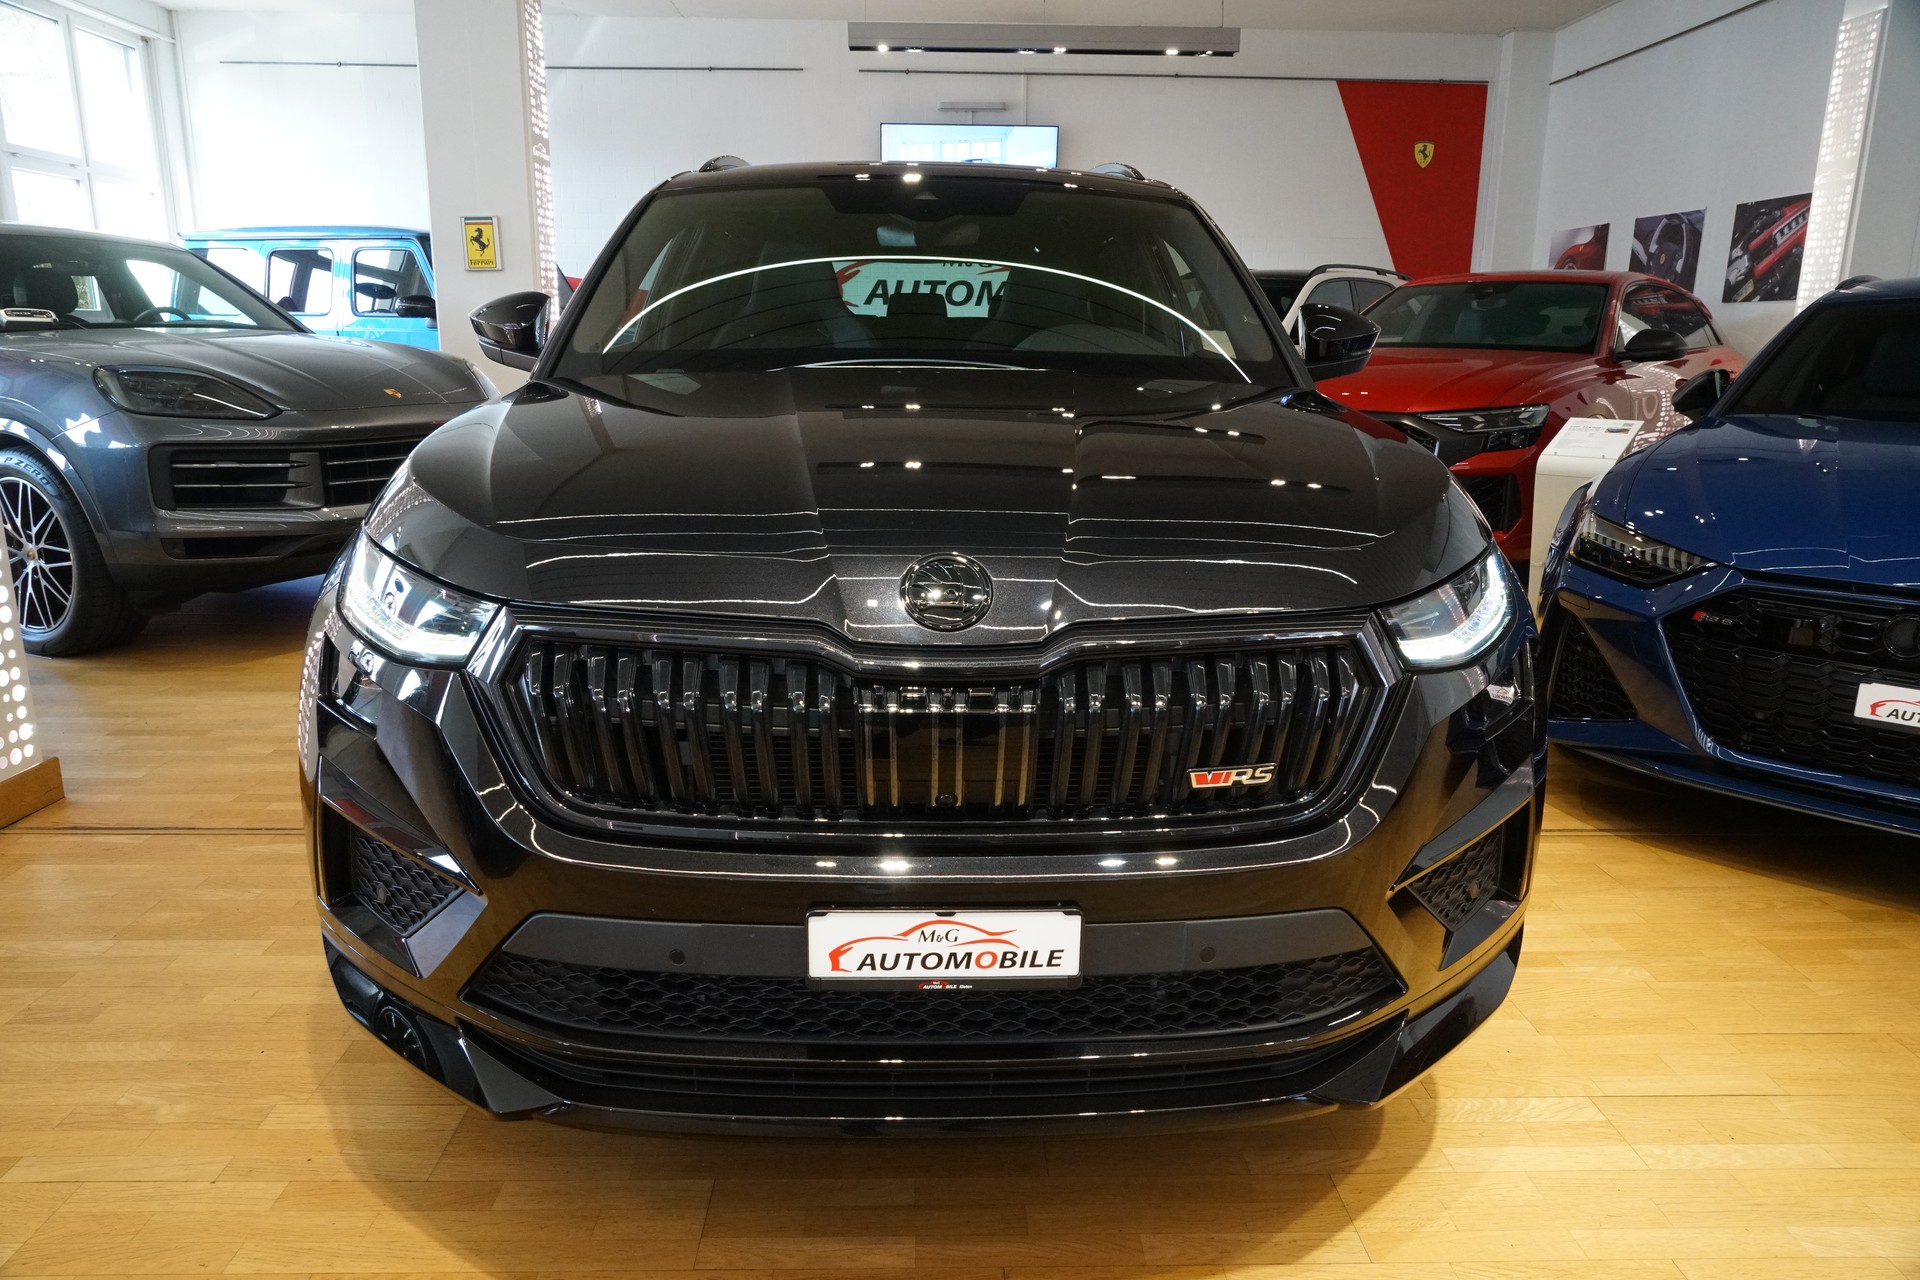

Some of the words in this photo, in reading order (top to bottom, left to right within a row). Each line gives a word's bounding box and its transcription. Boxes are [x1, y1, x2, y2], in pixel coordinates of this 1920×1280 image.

[14, 459, 51, 486] ZERO
[918, 929, 959, 943] M&G
[856, 949, 1064, 972] AUTOMOBILE
